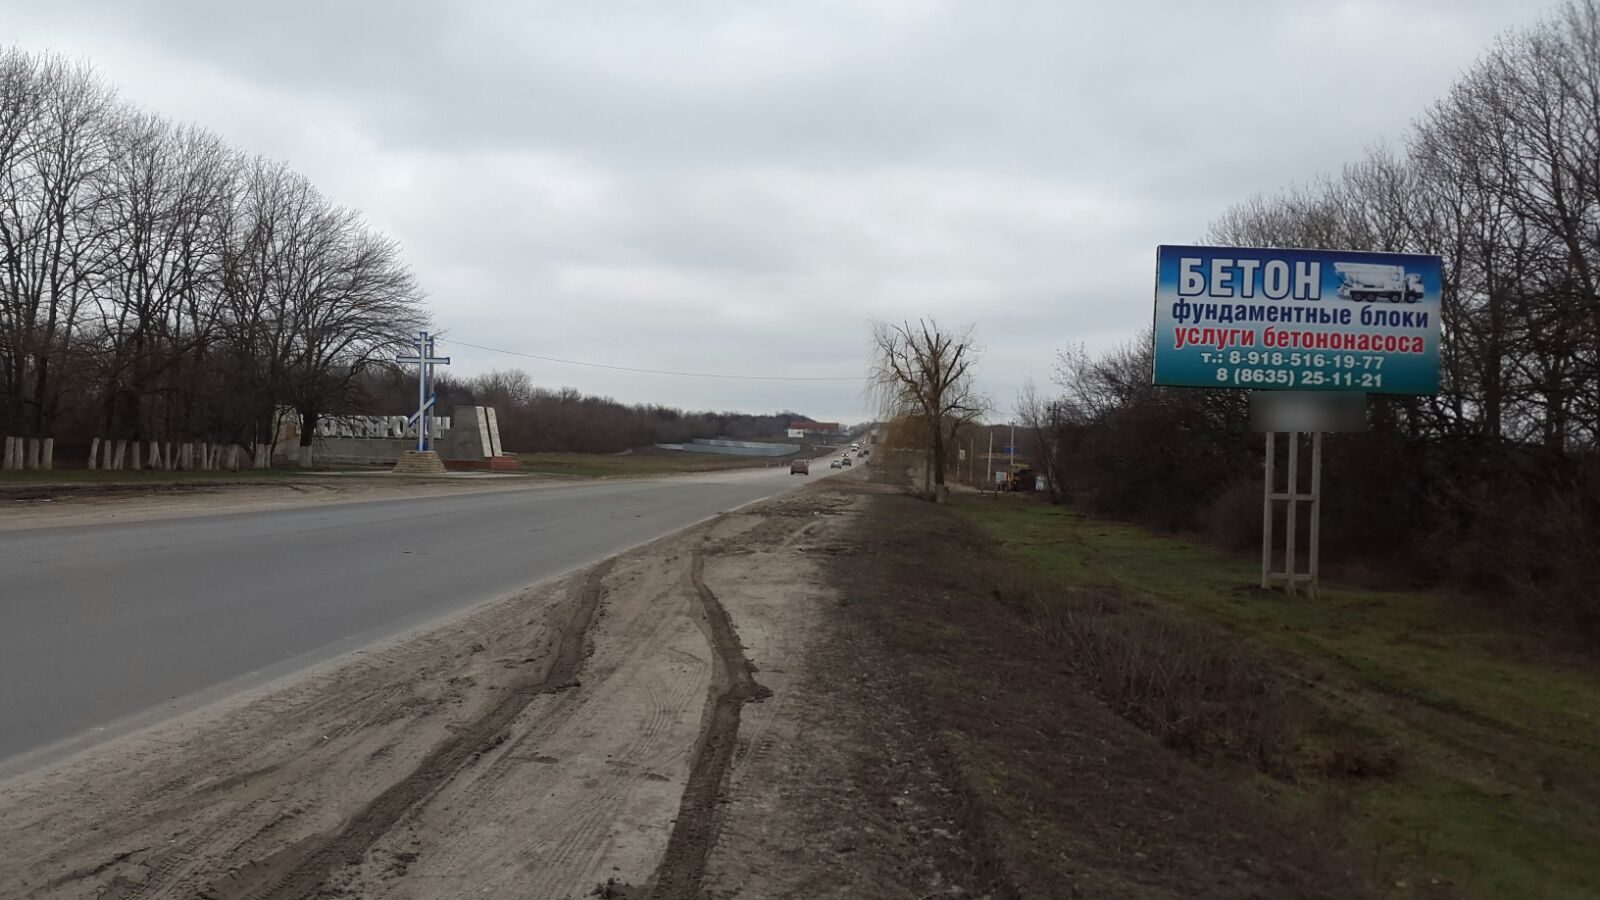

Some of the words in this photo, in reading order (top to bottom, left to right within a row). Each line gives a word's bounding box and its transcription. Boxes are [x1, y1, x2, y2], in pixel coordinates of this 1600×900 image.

[1178, 256, 1321, 301] БЕТОН
[1172, 298, 1352, 325] фундаментные
[1360, 305, 1428, 328] блоки
[1175, 327, 1254, 350] услуги
[1263, 326, 1424, 353] бетононасоса
[1201, 352, 1223, 363] т.:
[1229, 350, 1385, 370] 8-918-516-19-77
[1216, 368, 1228, 381] 8
[1234, 368, 1295, 387] (8635)
[1301, 371, 1382, 387] 25-11-21
